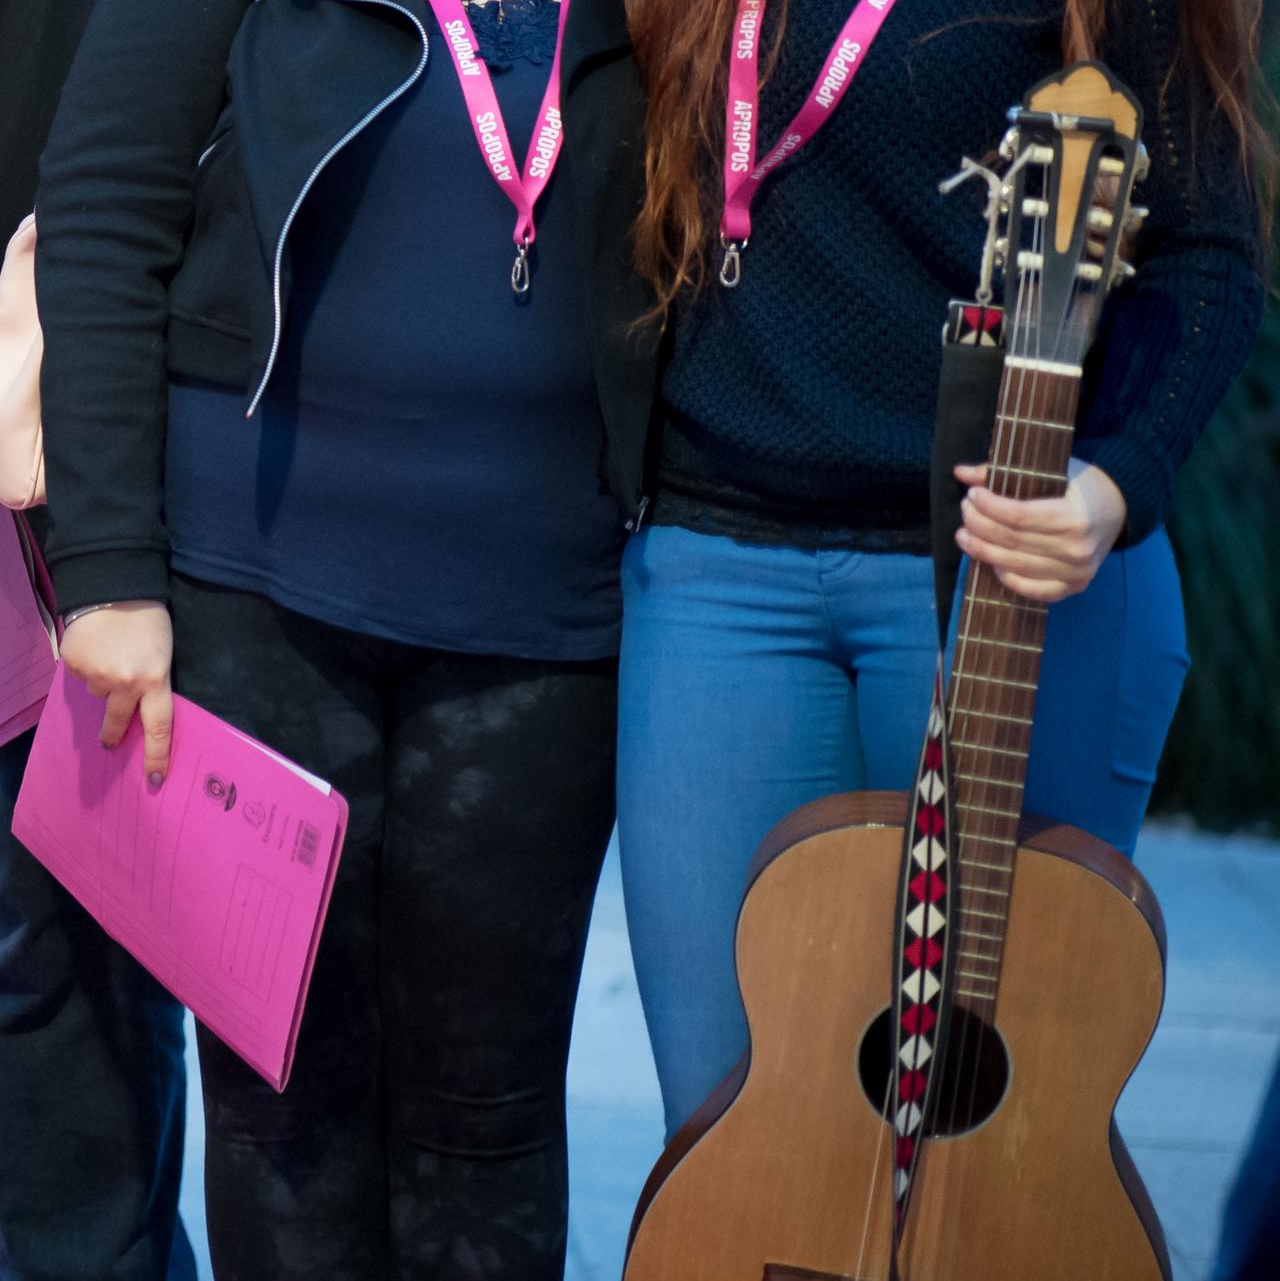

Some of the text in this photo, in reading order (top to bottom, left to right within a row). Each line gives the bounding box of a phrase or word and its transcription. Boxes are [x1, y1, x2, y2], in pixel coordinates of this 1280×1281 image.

[445, 20, 481, 76] APROPOS
[815, 38, 861, 108] APROPOS
[476, 112, 513, 181] APROPOS
[529, 106, 562, 178] APROPOS
[731, 100, 752, 173] APROPOS
